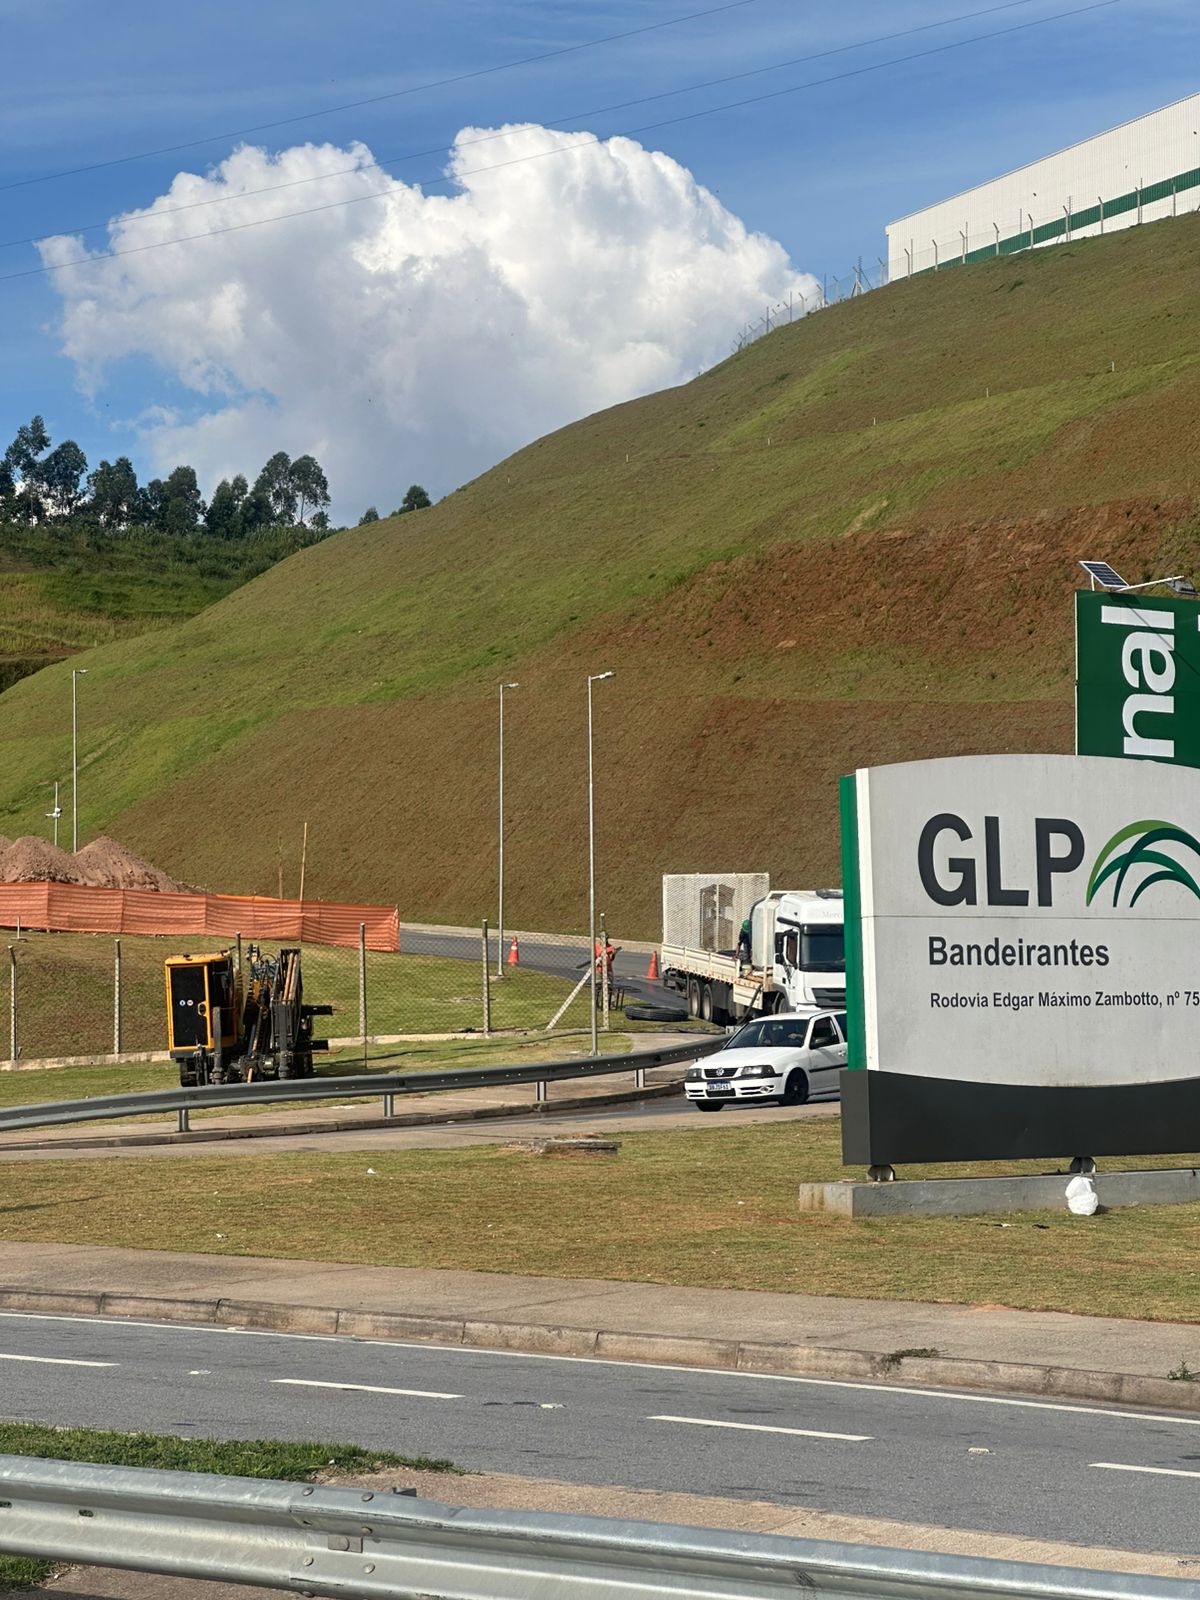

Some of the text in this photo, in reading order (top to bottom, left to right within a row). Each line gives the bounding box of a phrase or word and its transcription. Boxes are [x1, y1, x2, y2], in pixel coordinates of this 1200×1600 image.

[917, 813, 1085, 907] GLP
[928, 936, 1110, 967] Bandeirantes
[930, 992, 989, 1008] Rodovia
[993, 992, 1035, 1012] Edgar
[1038, 991, 1092, 1007] Máximo
[1095, 991, 1163, 1009] Zambotto,
